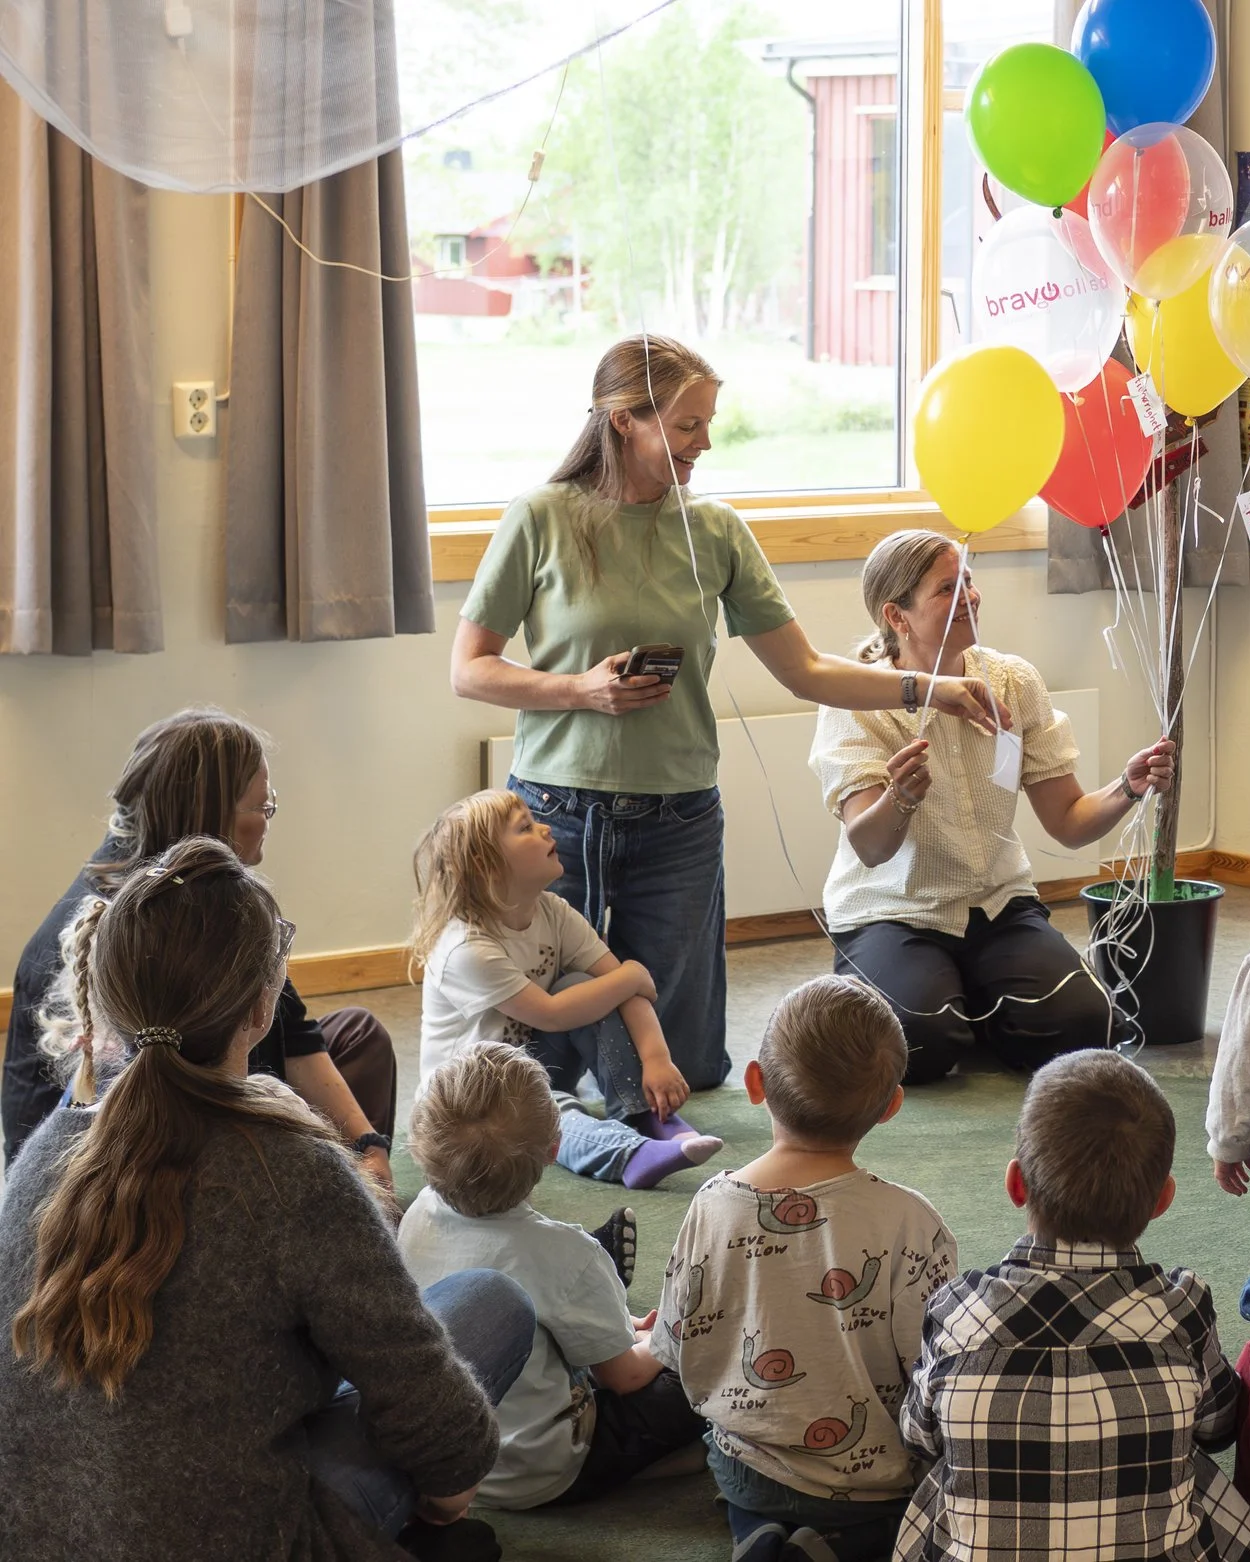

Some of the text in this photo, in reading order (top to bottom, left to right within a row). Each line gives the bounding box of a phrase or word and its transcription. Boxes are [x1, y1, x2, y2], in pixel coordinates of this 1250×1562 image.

[1208, 206, 1232, 227] ball
[727, 1235, 766, 1249] LIVE
[745, 1245, 788, 1259] SLOW
[901, 1246, 926, 1263] LIV
[926, 1254, 950, 1280] LIVE
[920, 1271, 948, 1302] SLOW
[688, 1309, 725, 1328] LIVE
[852, 1307, 888, 1321] LIVE
[840, 1318, 875, 1332] SLOW
[682, 1325, 713, 1341] LOW
[721, 1388, 750, 1398] LIVE
[875, 1384, 902, 1393] IVE
[730, 1399, 768, 1411] SLOW
[850, 1445, 887, 1461] LIVE
[836, 1460, 875, 1474] LOW
